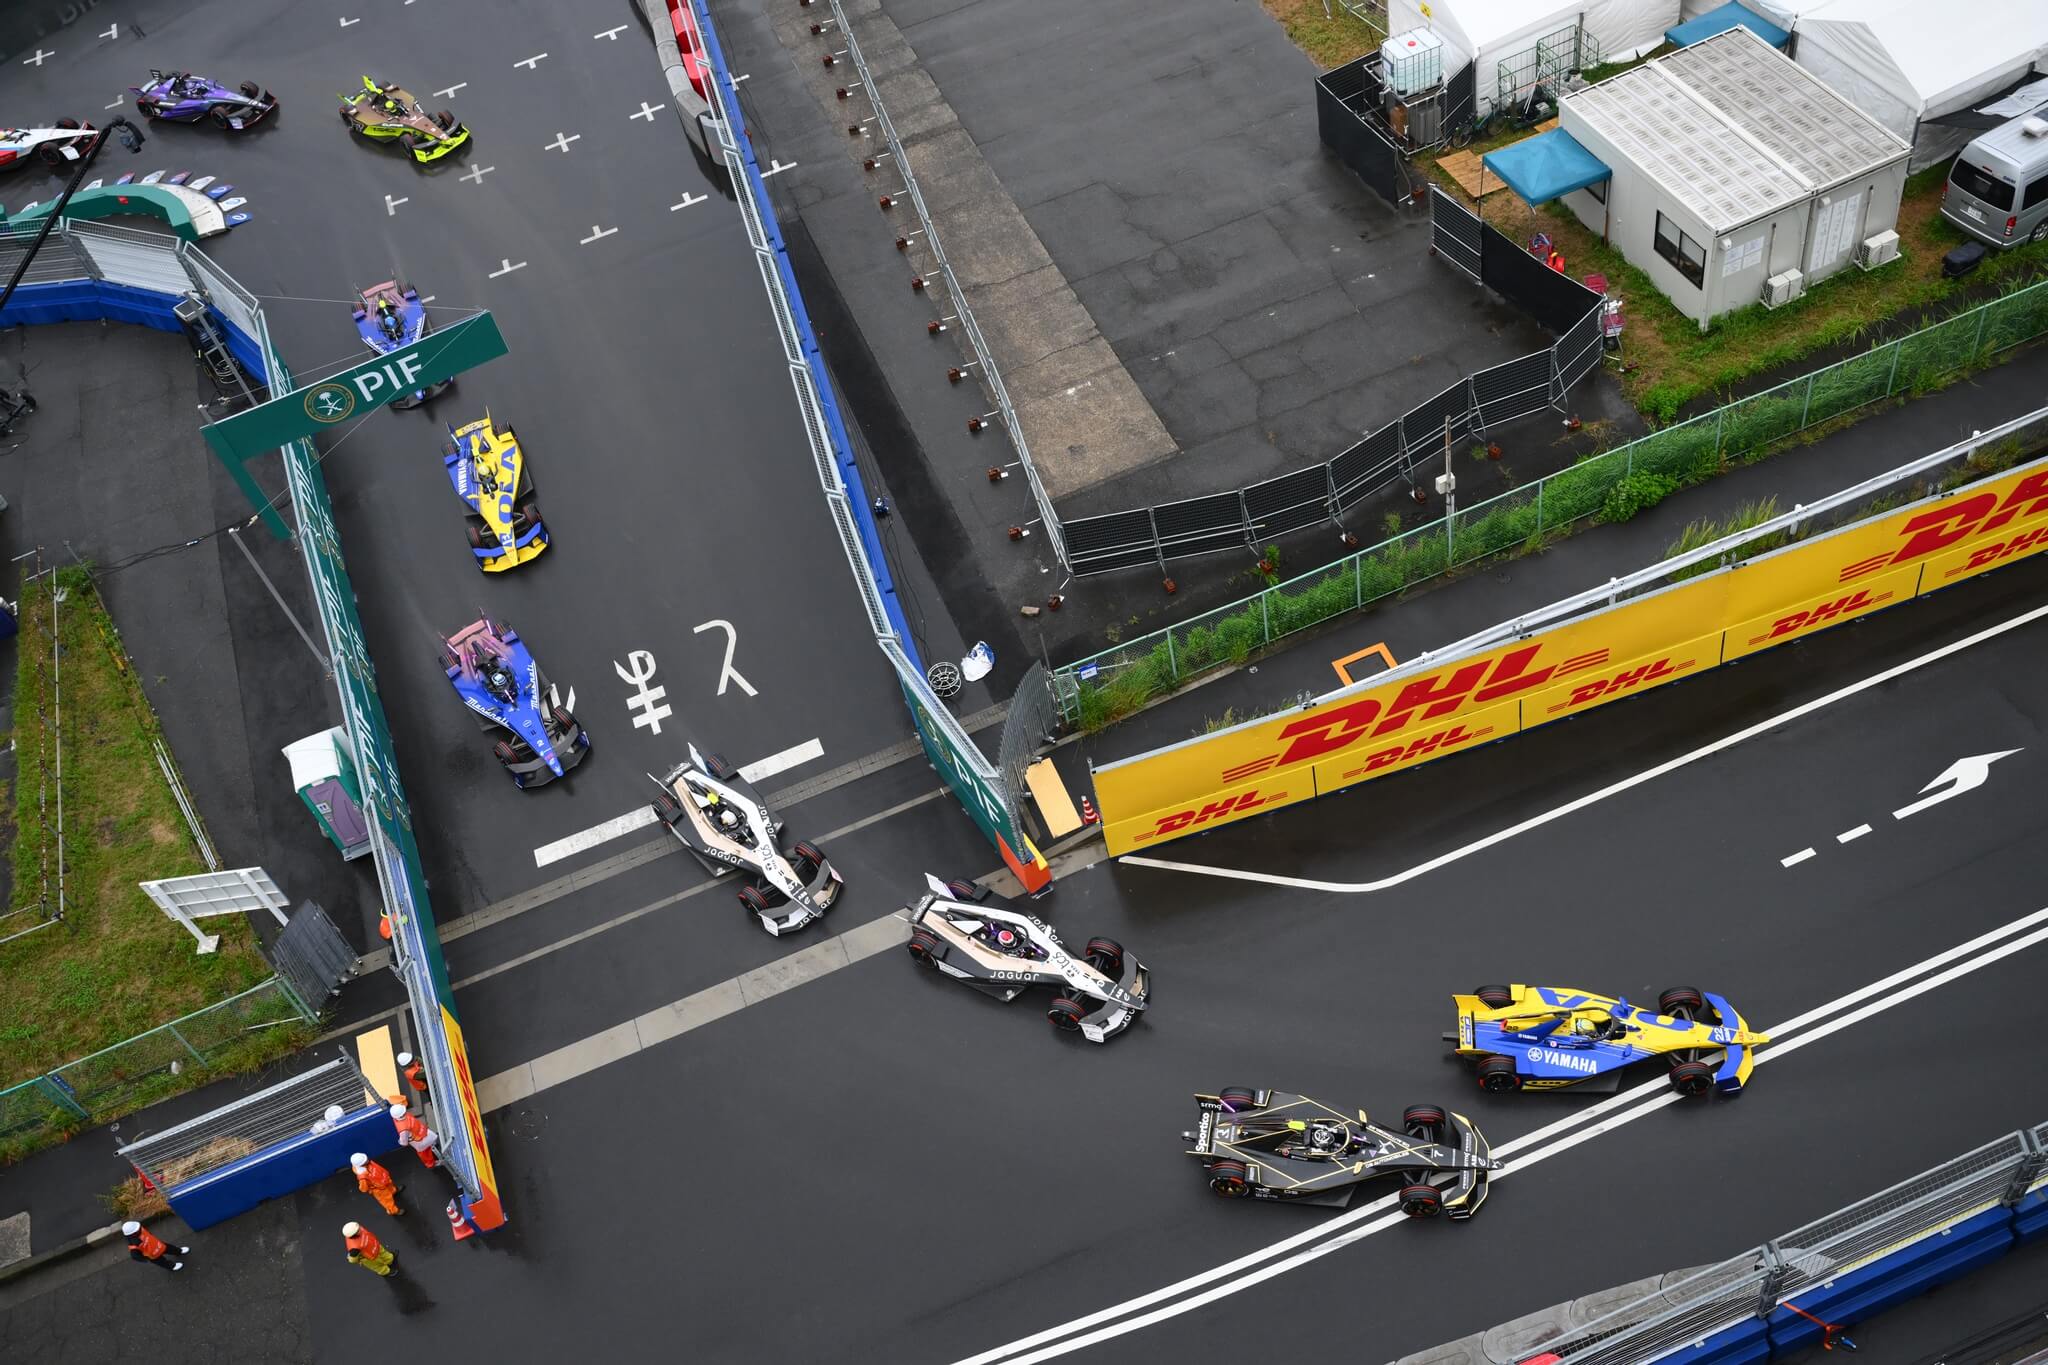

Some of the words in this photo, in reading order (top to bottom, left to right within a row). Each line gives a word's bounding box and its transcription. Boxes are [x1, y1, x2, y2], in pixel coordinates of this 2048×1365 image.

[353, 352, 422, 402] PIF
[458, 465, 467, 495] YAMAHA
[321, 505, 339, 547] PIF
[1964, 527, 2048, 571] DH
[1768, 589, 1874, 639] DHL
[350, 622, 369, 667] PIF
[1276, 643, 1558, 767] DHL
[1568, 658, 1677, 707] DHL
[355, 702, 382, 772] PIF
[1363, 725, 1473, 773] DHL
[383, 753, 403, 802] PIF
[951, 750, 1001, 823] PIF
[1155, 790, 1267, 836] DHL
[1714, 1028, 1725, 1042] 22
[1543, 1051, 1598, 1074] YAMAHA
[1195, 1112, 1210, 1153] Sportico
[1434, 1150, 1444, 1158] 7
